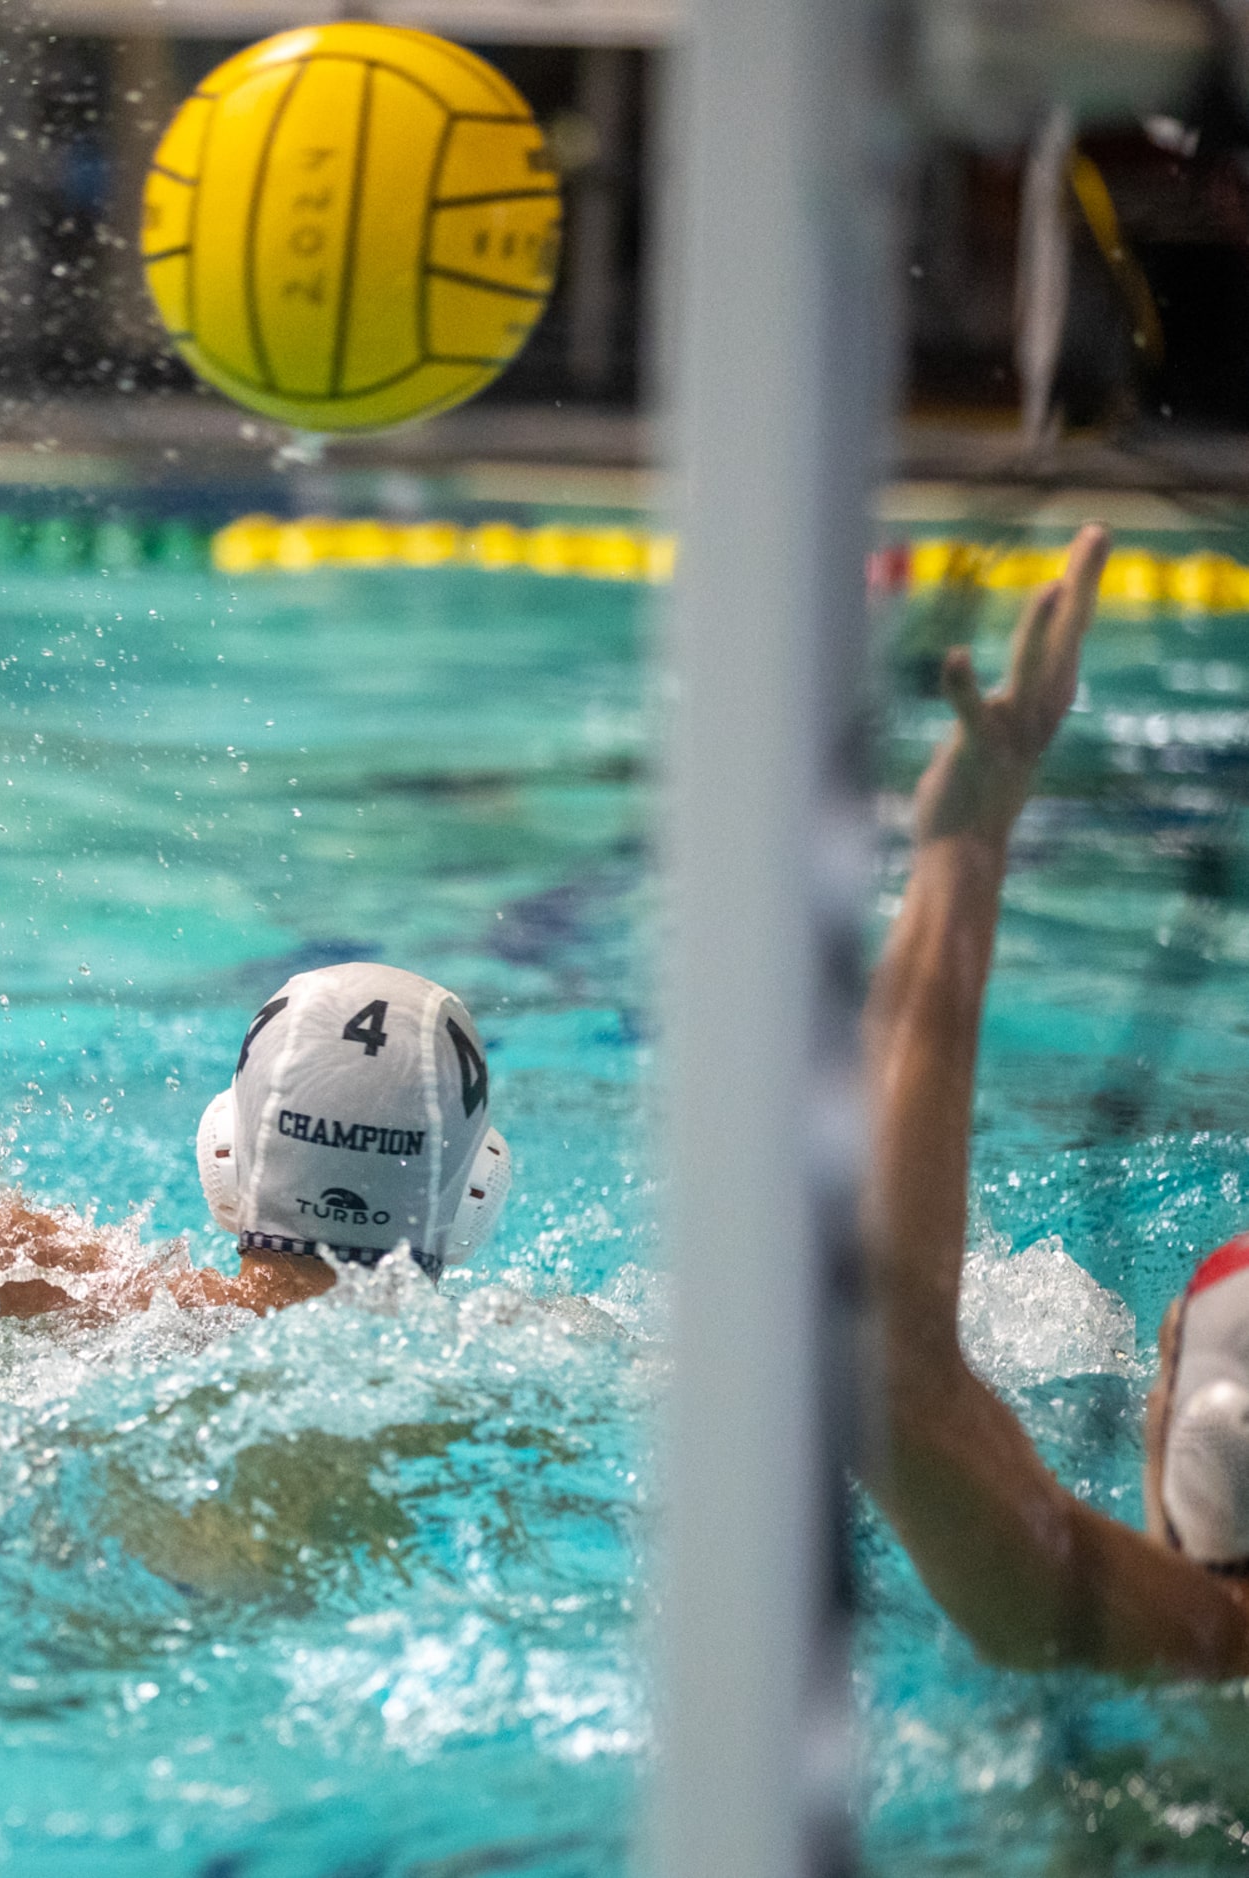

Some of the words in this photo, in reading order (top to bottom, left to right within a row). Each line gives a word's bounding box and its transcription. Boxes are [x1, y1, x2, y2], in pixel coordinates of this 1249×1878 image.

[342, 1000, 388, 1057] 4
[278, 1109, 426, 1157] CHAMPION
[296, 1198, 391, 1226] TURBO
